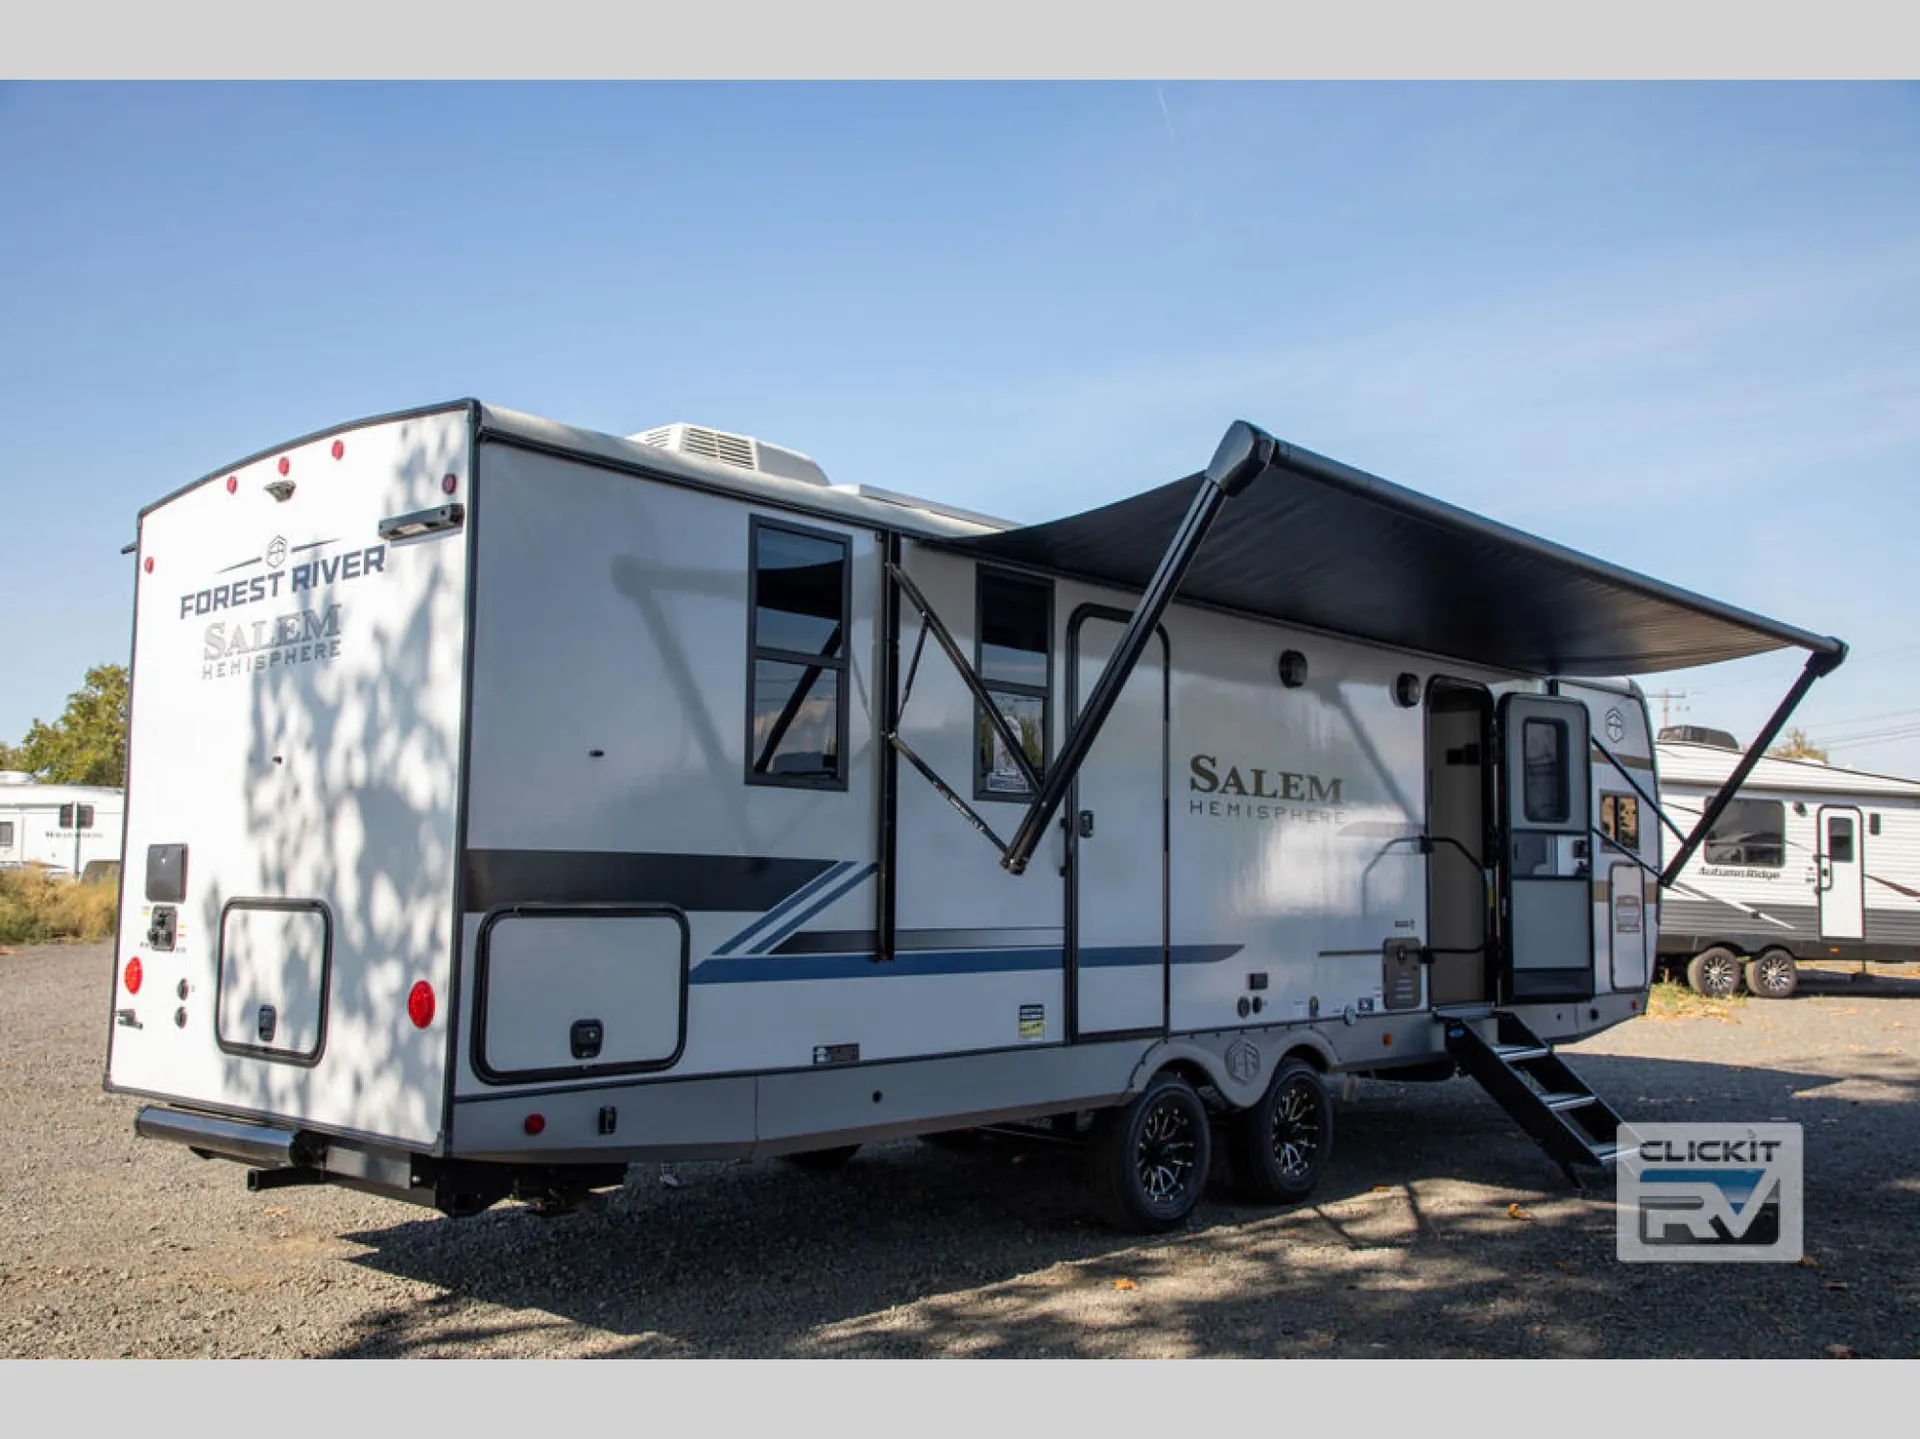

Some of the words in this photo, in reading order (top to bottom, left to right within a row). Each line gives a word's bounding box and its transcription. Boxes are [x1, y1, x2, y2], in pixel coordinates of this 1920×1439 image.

[180, 570, 285, 620] FOREST
[291, 544, 386, 593] RIVER
[203, 604, 342, 661] SALEM
[201, 640, 342, 681] HEMISPHERE
[1190, 754, 1344, 804] SALEM
[1190, 800, 1345, 824] HEMISPHERE
